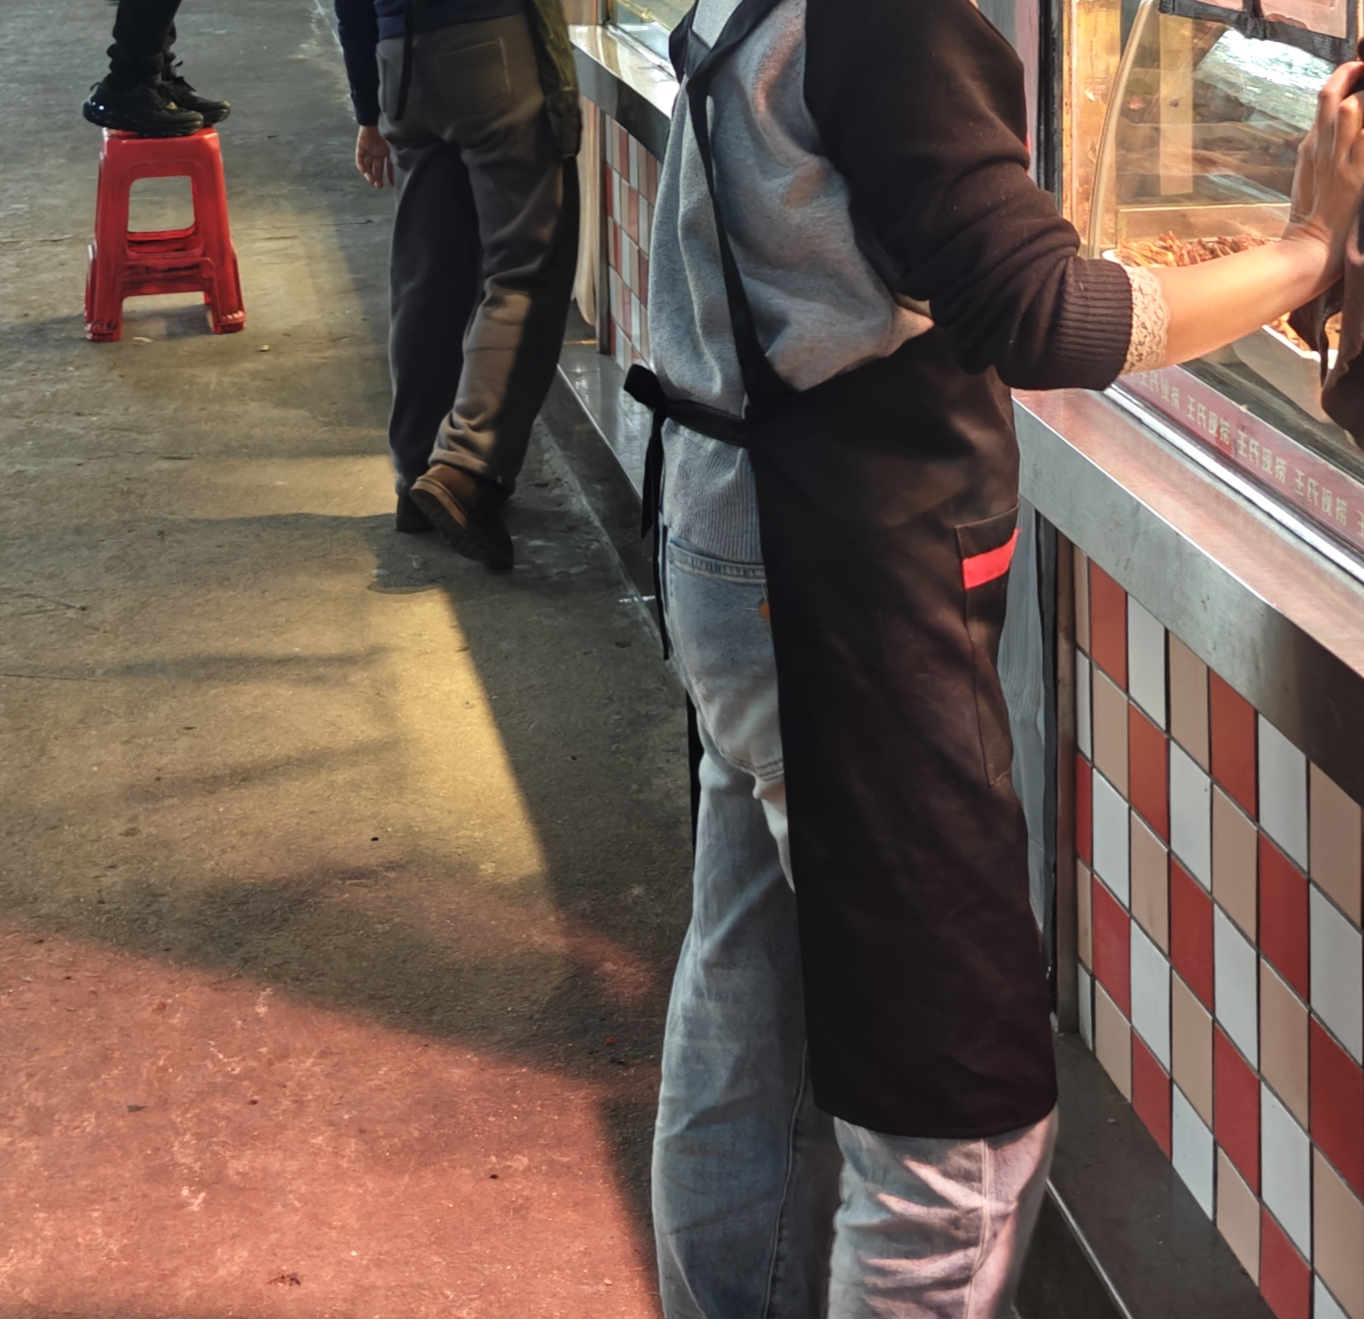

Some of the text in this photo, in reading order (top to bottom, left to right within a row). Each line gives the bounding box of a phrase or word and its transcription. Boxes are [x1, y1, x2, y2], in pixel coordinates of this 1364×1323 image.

[1186, 394, 1232, 446] 王氏现捞
[1236, 429, 1286, 484] 王氏现捞
[1293, 469, 1348, 527] 王氏现捞
